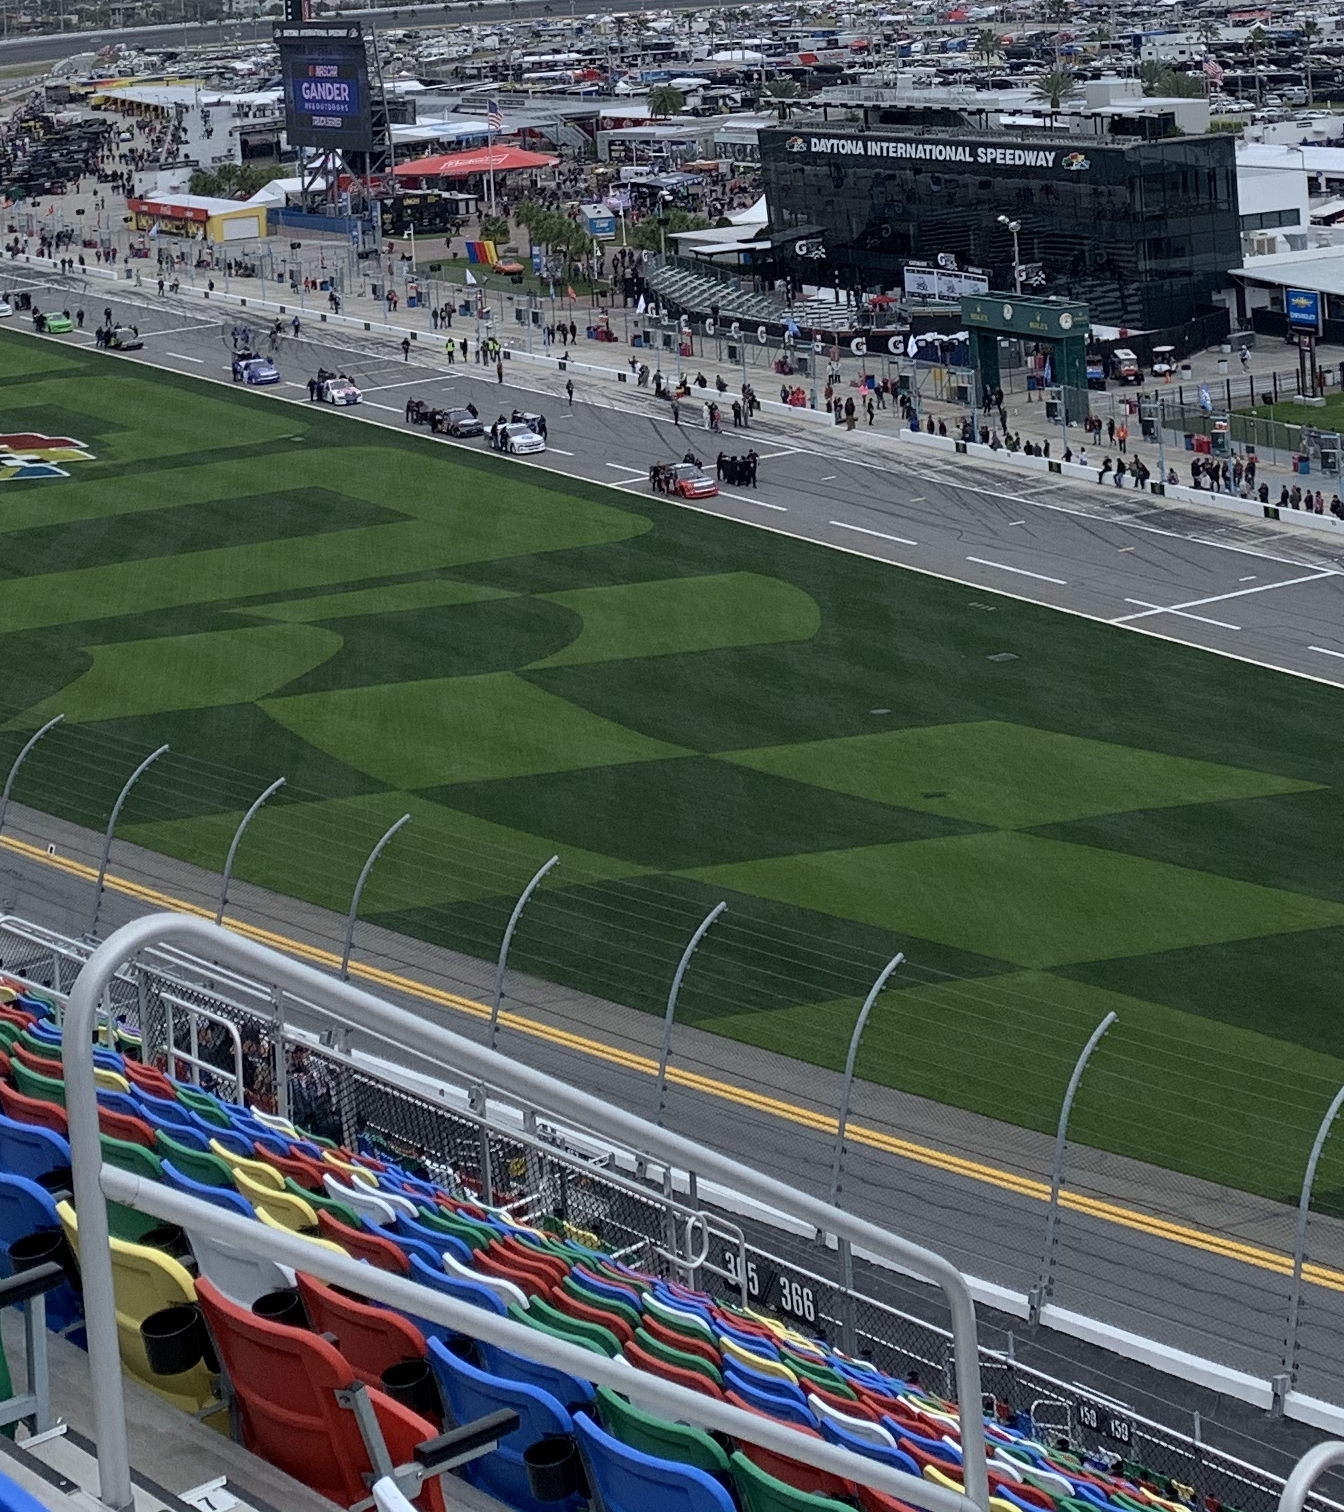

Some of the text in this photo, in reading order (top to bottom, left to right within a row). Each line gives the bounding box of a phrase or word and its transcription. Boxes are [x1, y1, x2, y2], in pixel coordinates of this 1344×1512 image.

[302, 82, 349, 101] GANDER
[811, 138, 1055, 168] DAYTONA INTERNATIONAL SPEEDWAY
[725, 1252, 815, 1322] 35 366
